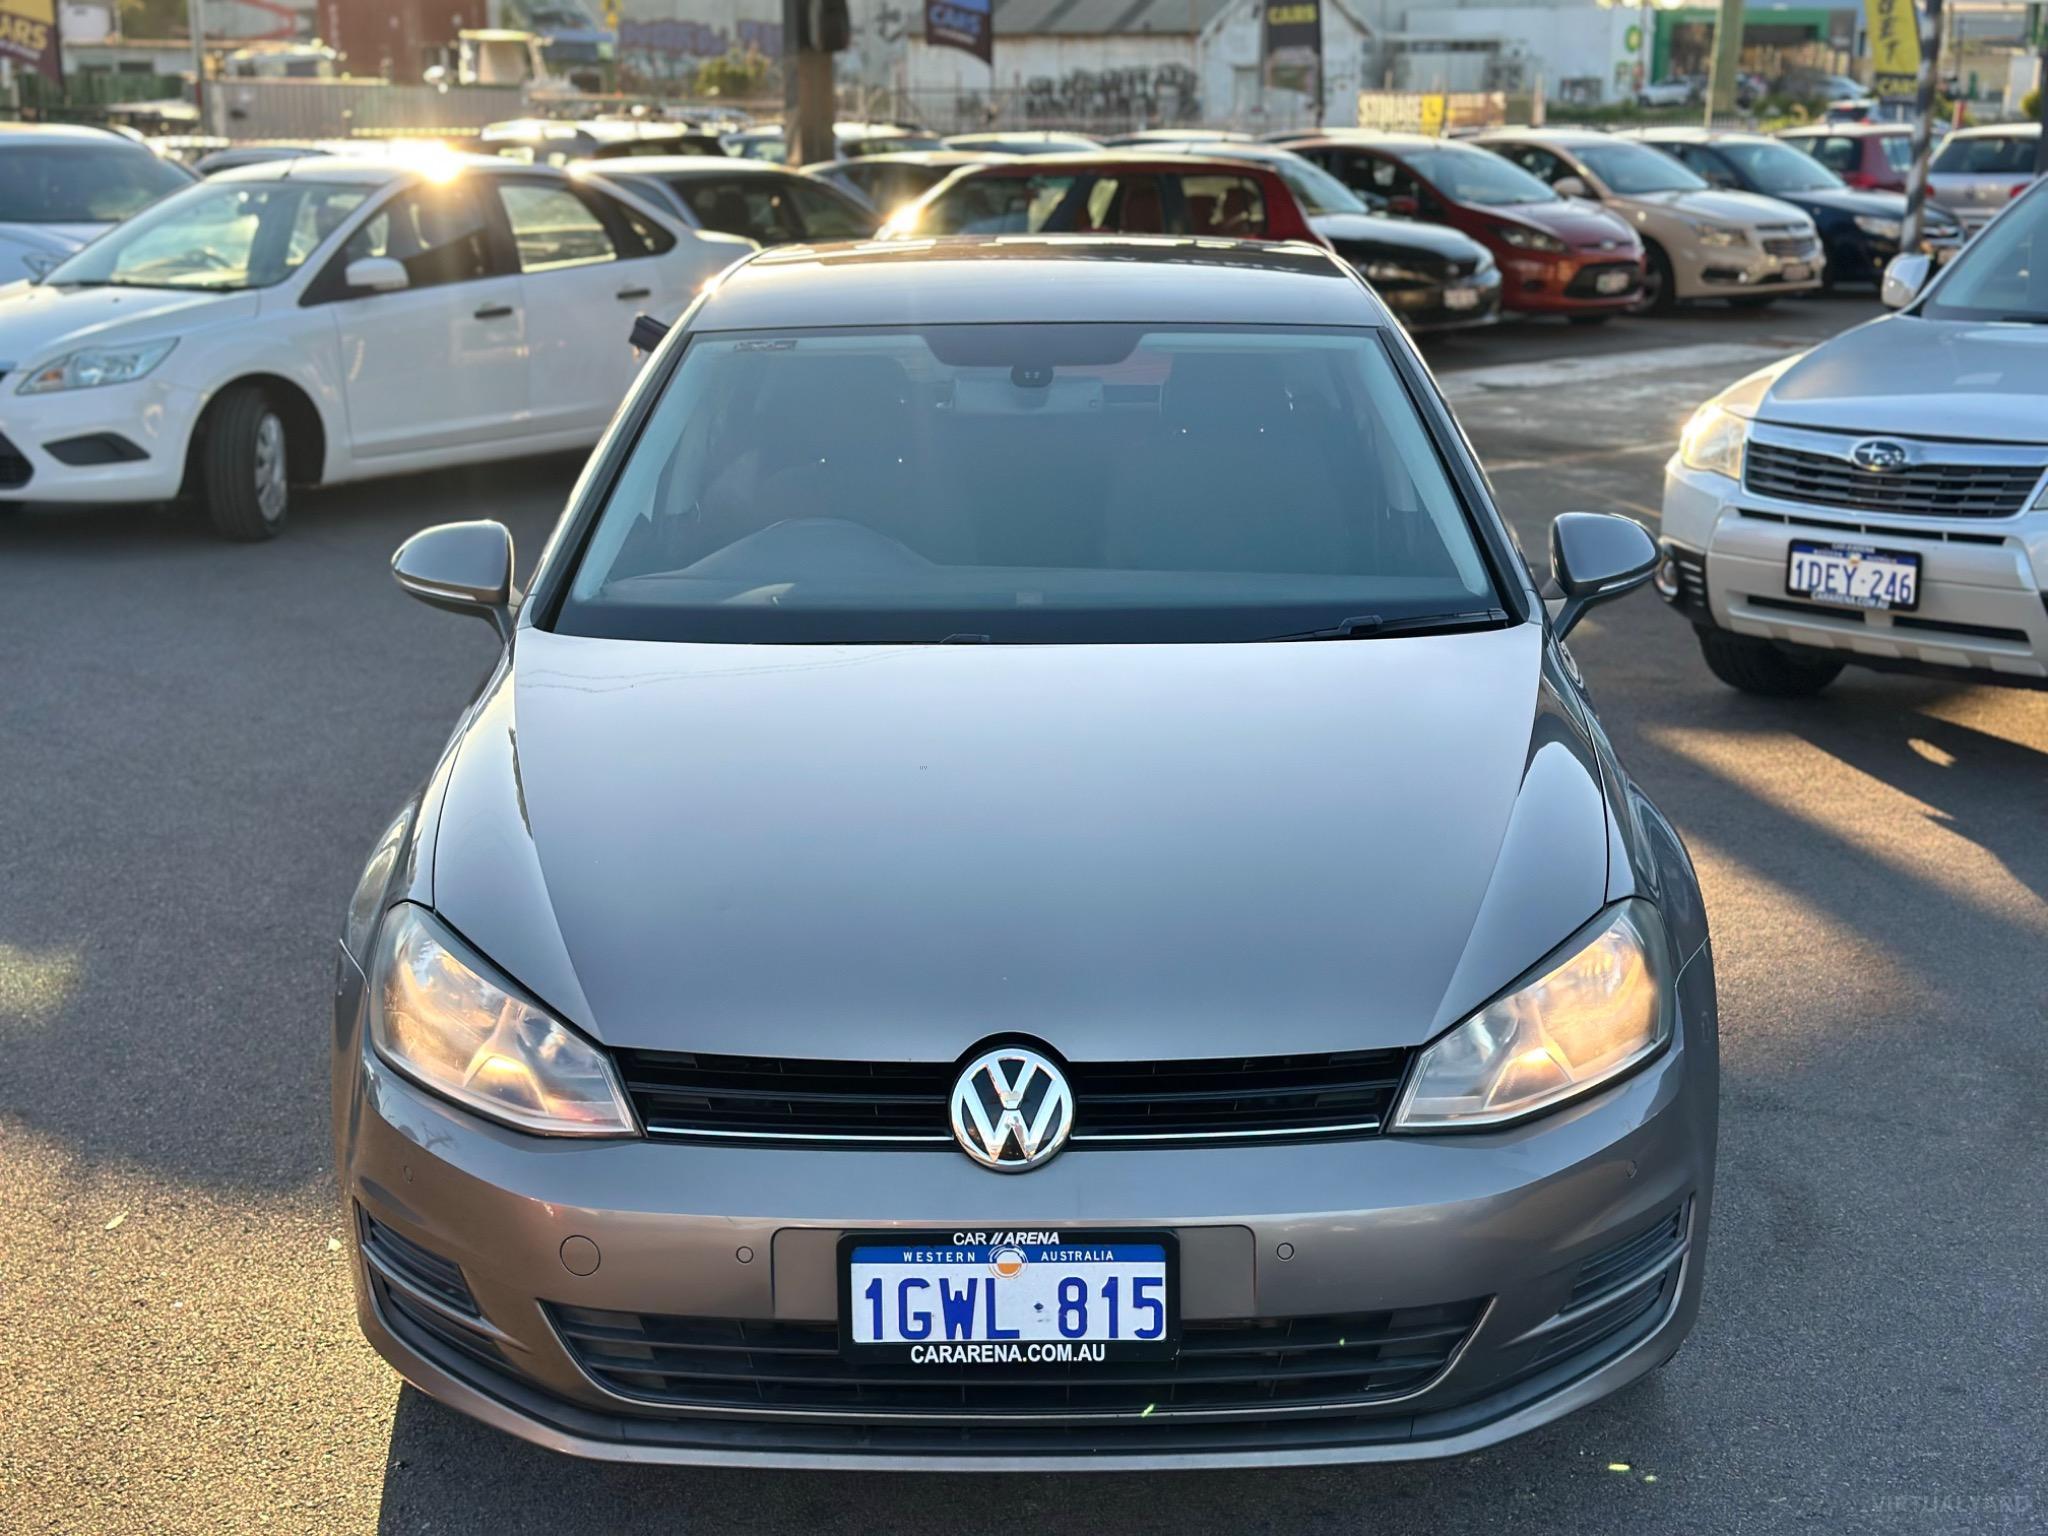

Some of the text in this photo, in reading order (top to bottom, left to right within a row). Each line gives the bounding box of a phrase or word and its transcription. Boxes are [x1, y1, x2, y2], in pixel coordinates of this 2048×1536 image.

[1269, 5, 1317, 25] CARS
[1796, 559, 1912, 604] 1DEY 246
[953, 1232, 987, 1246] CAR
[903, 1250, 1114, 1263] WESTERN AUSTRALIA
[865, 1276, 1164, 1341] 1GWL 815
[910, 1344, 1106, 1364] CARARENA.COM.AU
